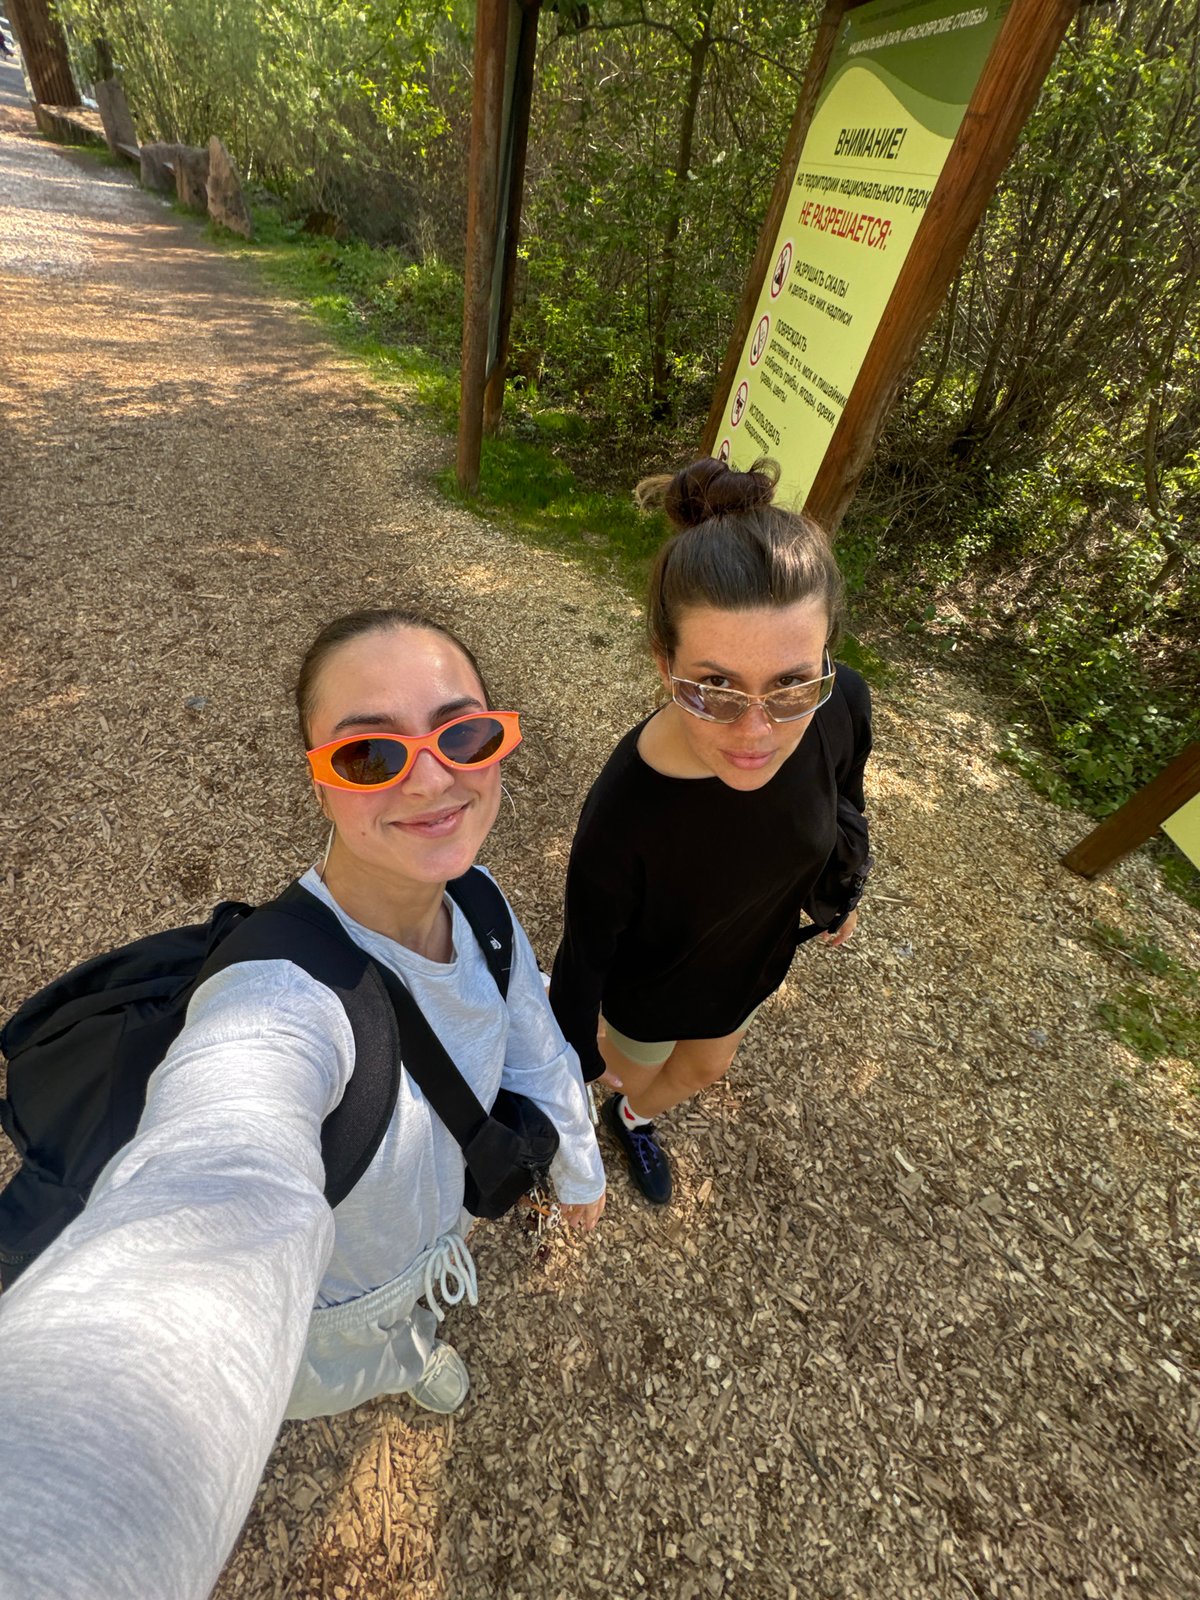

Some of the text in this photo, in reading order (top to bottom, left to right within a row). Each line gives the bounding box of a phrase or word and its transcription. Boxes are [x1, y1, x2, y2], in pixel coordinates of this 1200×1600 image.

[834, 128, 907, 160] ВНИМАНИЕ!
[796, 172, 932, 214] на территории национального парк
[798, 200, 892, 251] НЕ РАЗРЕШАЕТСЯ:
[793, 260, 850, 298] РАЗРУШАТЬ СКАЛЫ
[807, 293, 816, 306] на
[814, 297, 827, 312] них
[825, 302, 853, 327] надписи
[775, 319, 807, 352] ПОВРЕЖДАТЬ
[798, 386, 817, 412] ягоды,
[816, 402, 836, 428] орехи,
[811, 373, 818, 384] и
[815, 377, 848, 409] лишайник
[749, 402, 780, 446] ИСПОЛЬЗОВАТЬ
